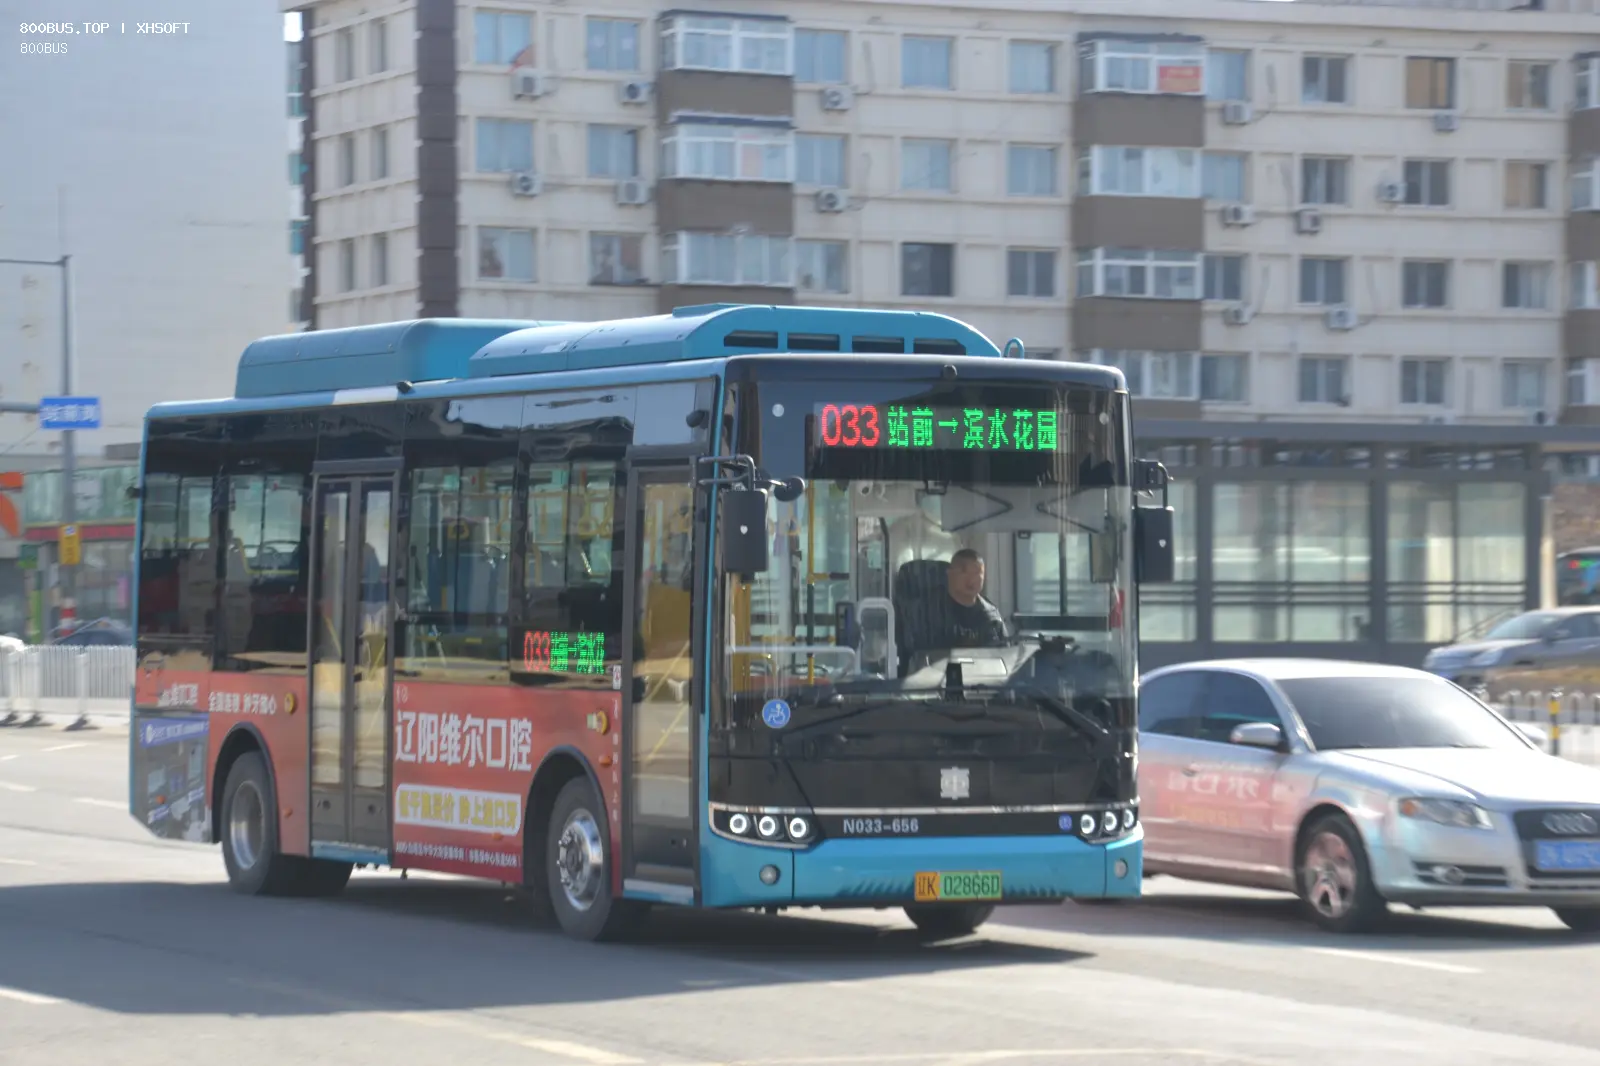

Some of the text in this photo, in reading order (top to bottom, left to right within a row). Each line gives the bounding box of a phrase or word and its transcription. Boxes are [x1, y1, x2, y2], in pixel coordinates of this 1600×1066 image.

[821, 404, 1057, 450] 033 站前 滨水花园
[524, 630, 550, 671] 033
[395, 710, 532, 772] 辽阳维尔口腔
[843, 817, 919, 834] N033-656
